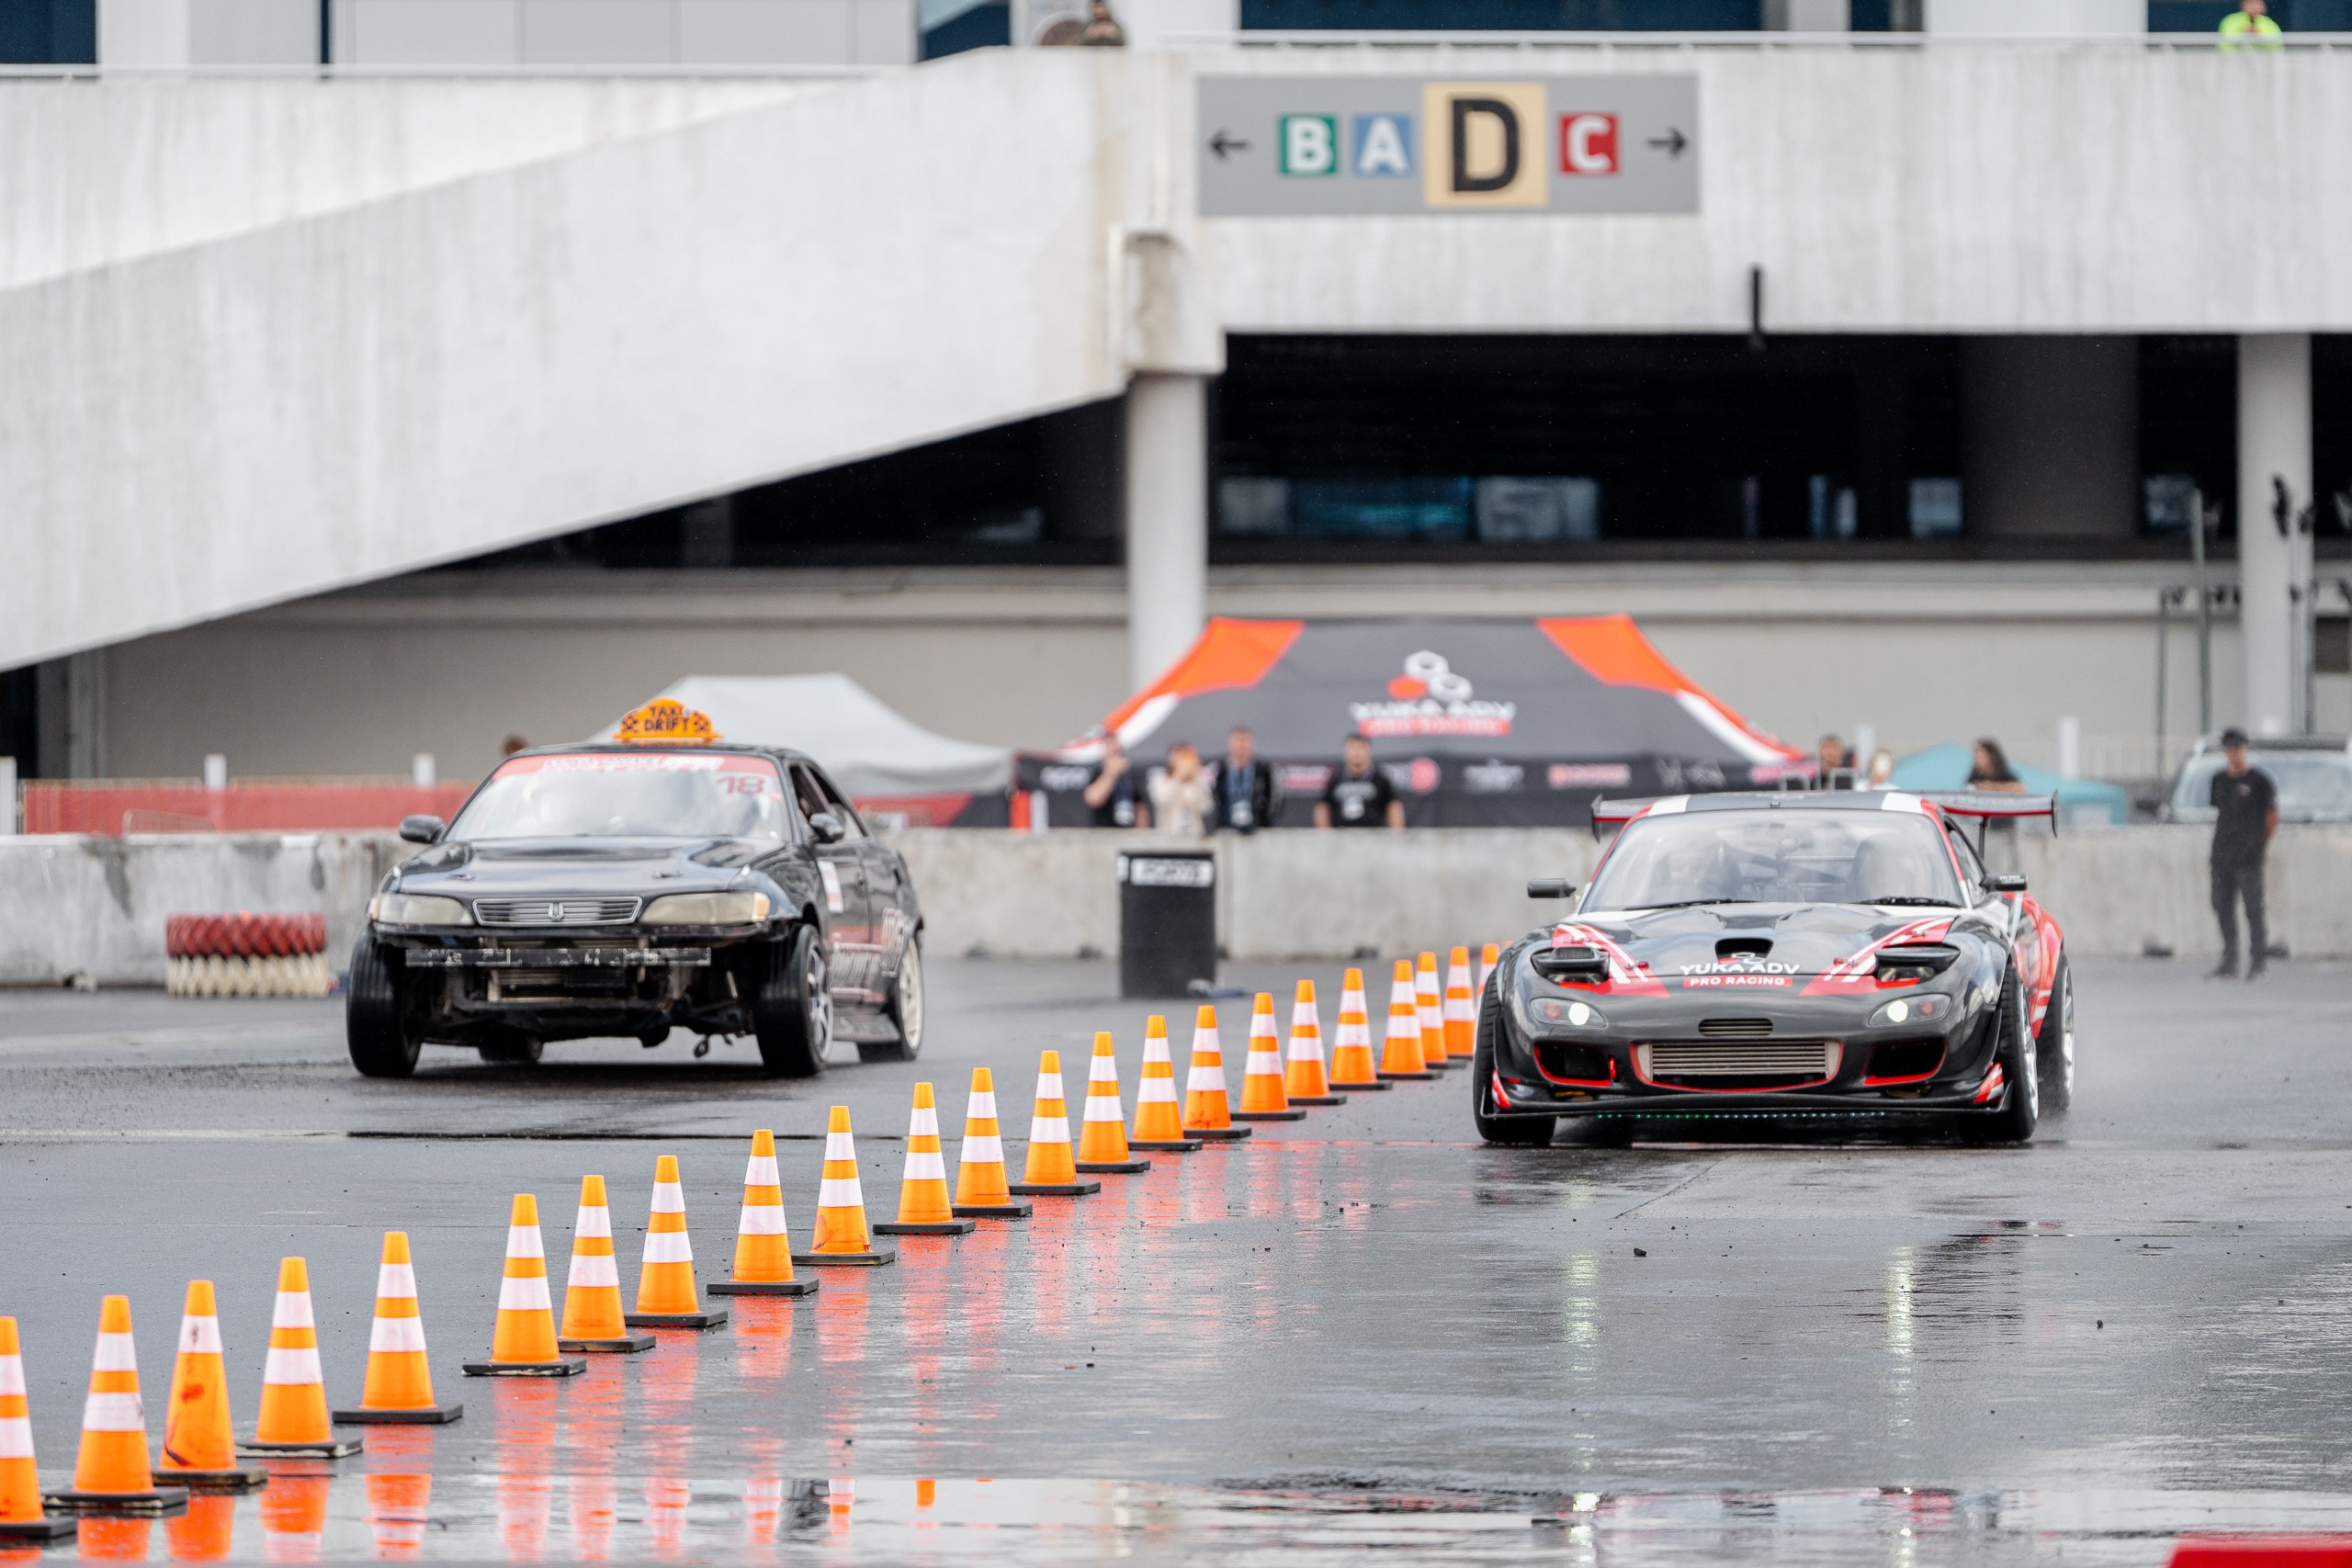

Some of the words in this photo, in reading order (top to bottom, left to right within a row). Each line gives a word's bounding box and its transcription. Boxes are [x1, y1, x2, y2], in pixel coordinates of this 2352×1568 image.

[1287, 116, 1335, 172] B
[1359, 117, 1410, 172] A
[1452, 97, 1521, 193] D
[1567, 115, 1612, 173] C
[650, 705, 684, 717] TAXI
[645, 717, 690, 732] DRIFT
[716, 776, 764, 795] 18
[1679, 963, 1745, 976] YUKA
[1749, 963, 1801, 975] ADV
[1690, 976, 1722, 987] PRO
[1725, 976, 1785, 986] RACING
